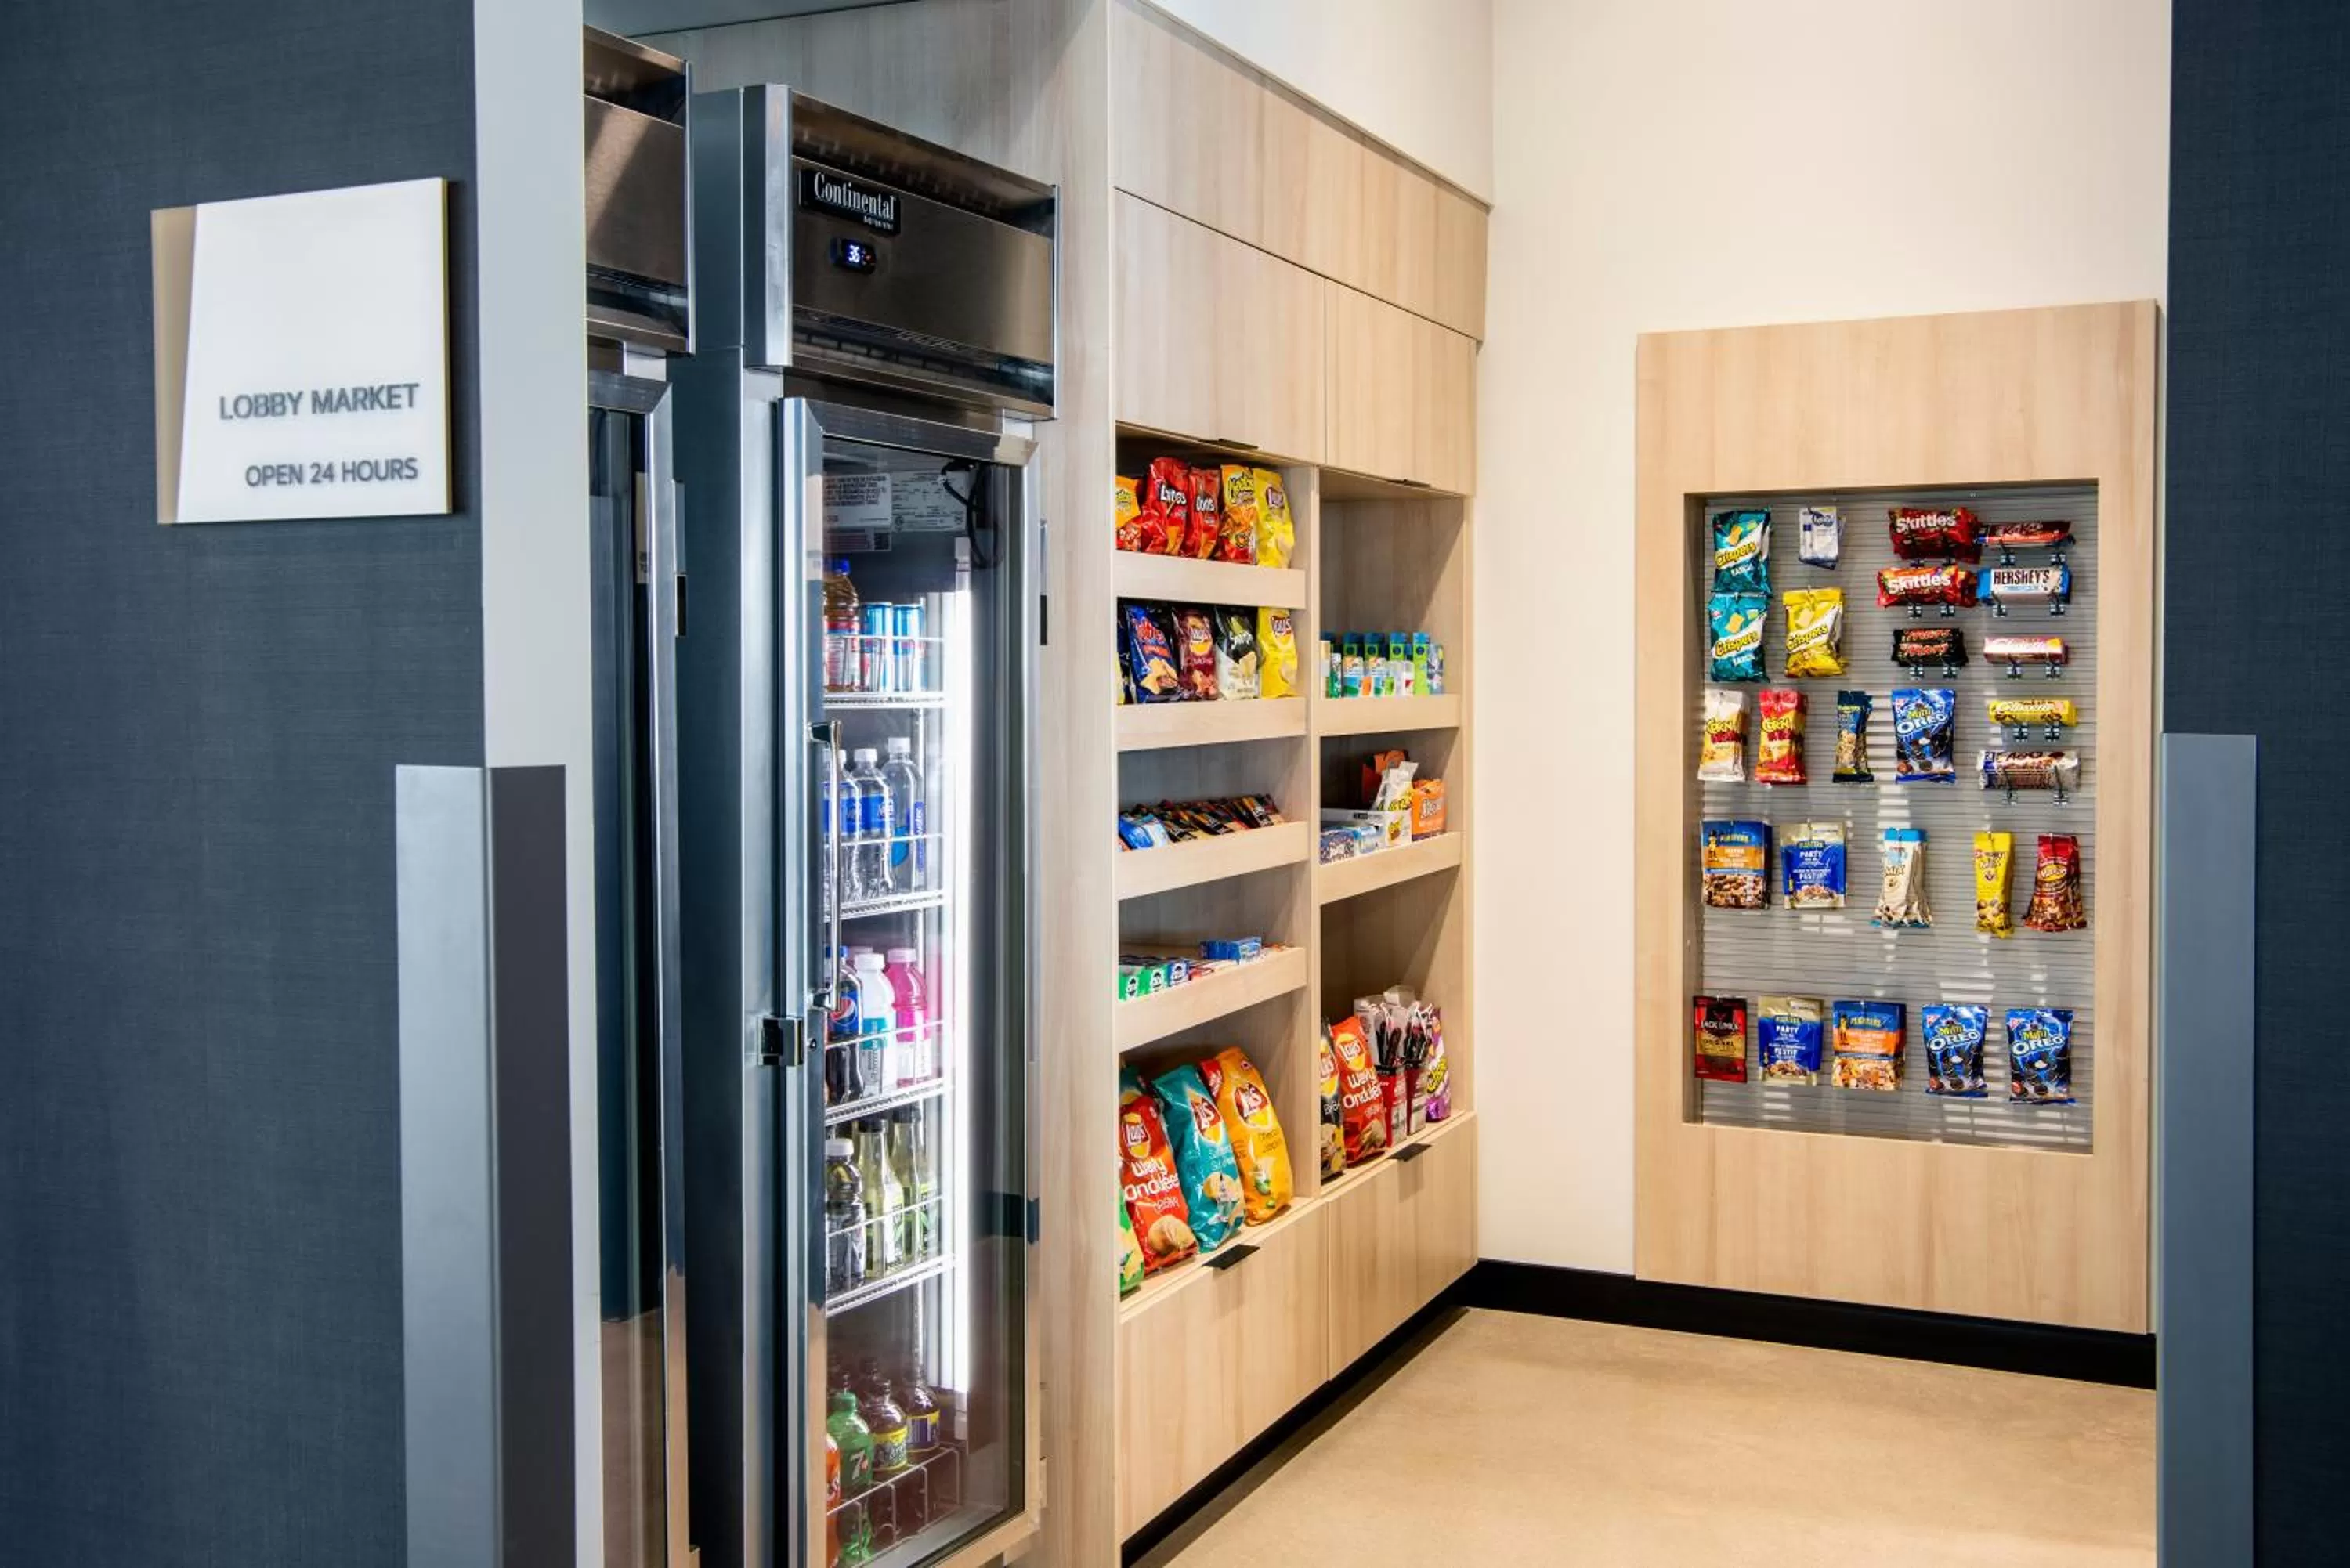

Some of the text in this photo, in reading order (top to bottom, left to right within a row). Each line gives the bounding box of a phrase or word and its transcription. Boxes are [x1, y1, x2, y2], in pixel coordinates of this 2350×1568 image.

[814, 172, 897, 220] Continental
[219, 383, 420, 421] LOBBY MARKET
[245, 457, 418, 487] OPEN 24 HOURS
[1896, 513, 1957, 533] Skittles
[1888, 575, 1951, 594] Skittles
[1715, 630, 1760, 656] Crispers
[1896, 712, 1947, 734] OREO
[1929, 1031, 1981, 1051] OREO
[2012, 1036, 2065, 1056] OREO
